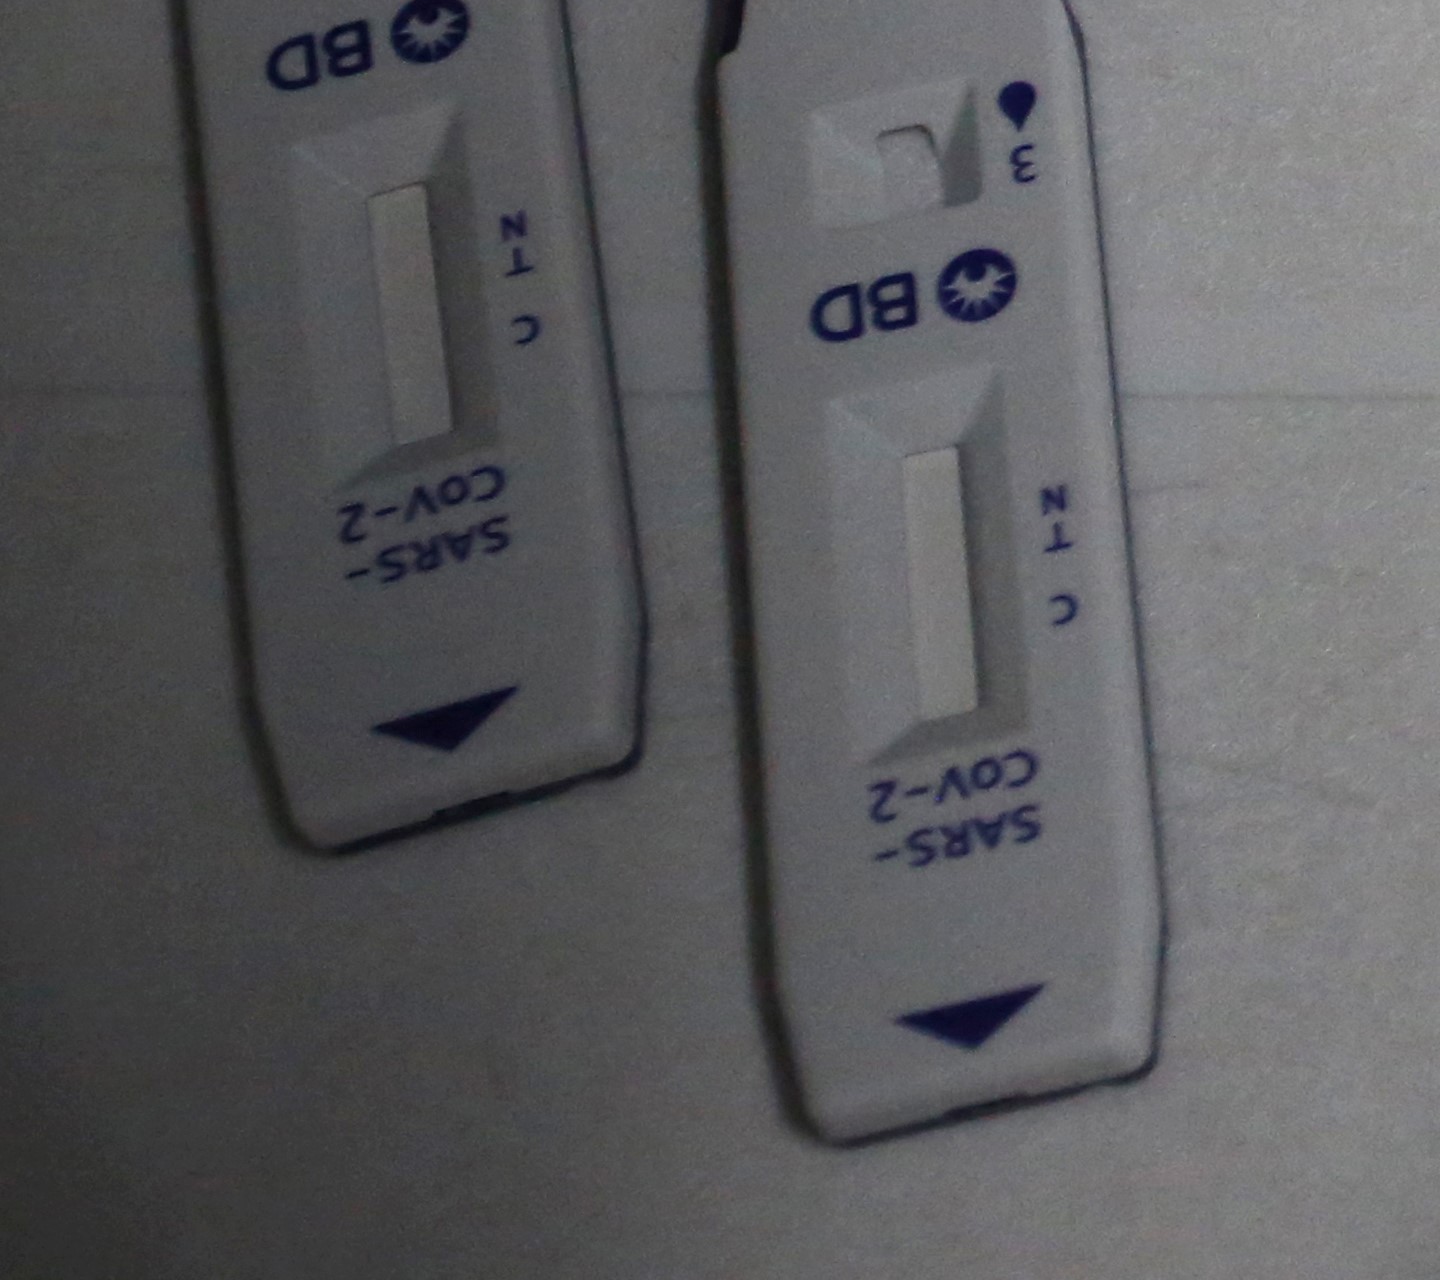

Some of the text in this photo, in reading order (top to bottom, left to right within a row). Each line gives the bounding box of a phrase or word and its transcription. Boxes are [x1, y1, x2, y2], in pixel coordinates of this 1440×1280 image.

[265, 19, 375, 94] BD
[1008, 142, 1036, 185] 3
[499, 211, 529, 239] N
[508, 245, 535, 277] T
[809, 271, 919, 343] BD
[513, 313, 544, 346] C
[341, 463, 513, 550] CoV-2
[1039, 488, 1069, 516] N
[341, 507, 513, 588] SARS-
[1044, 523, 1073, 555] T
[1049, 592, 1081, 628] C
[868, 750, 1041, 829] CoV-2
[869, 794, 1042, 869] SARS-
